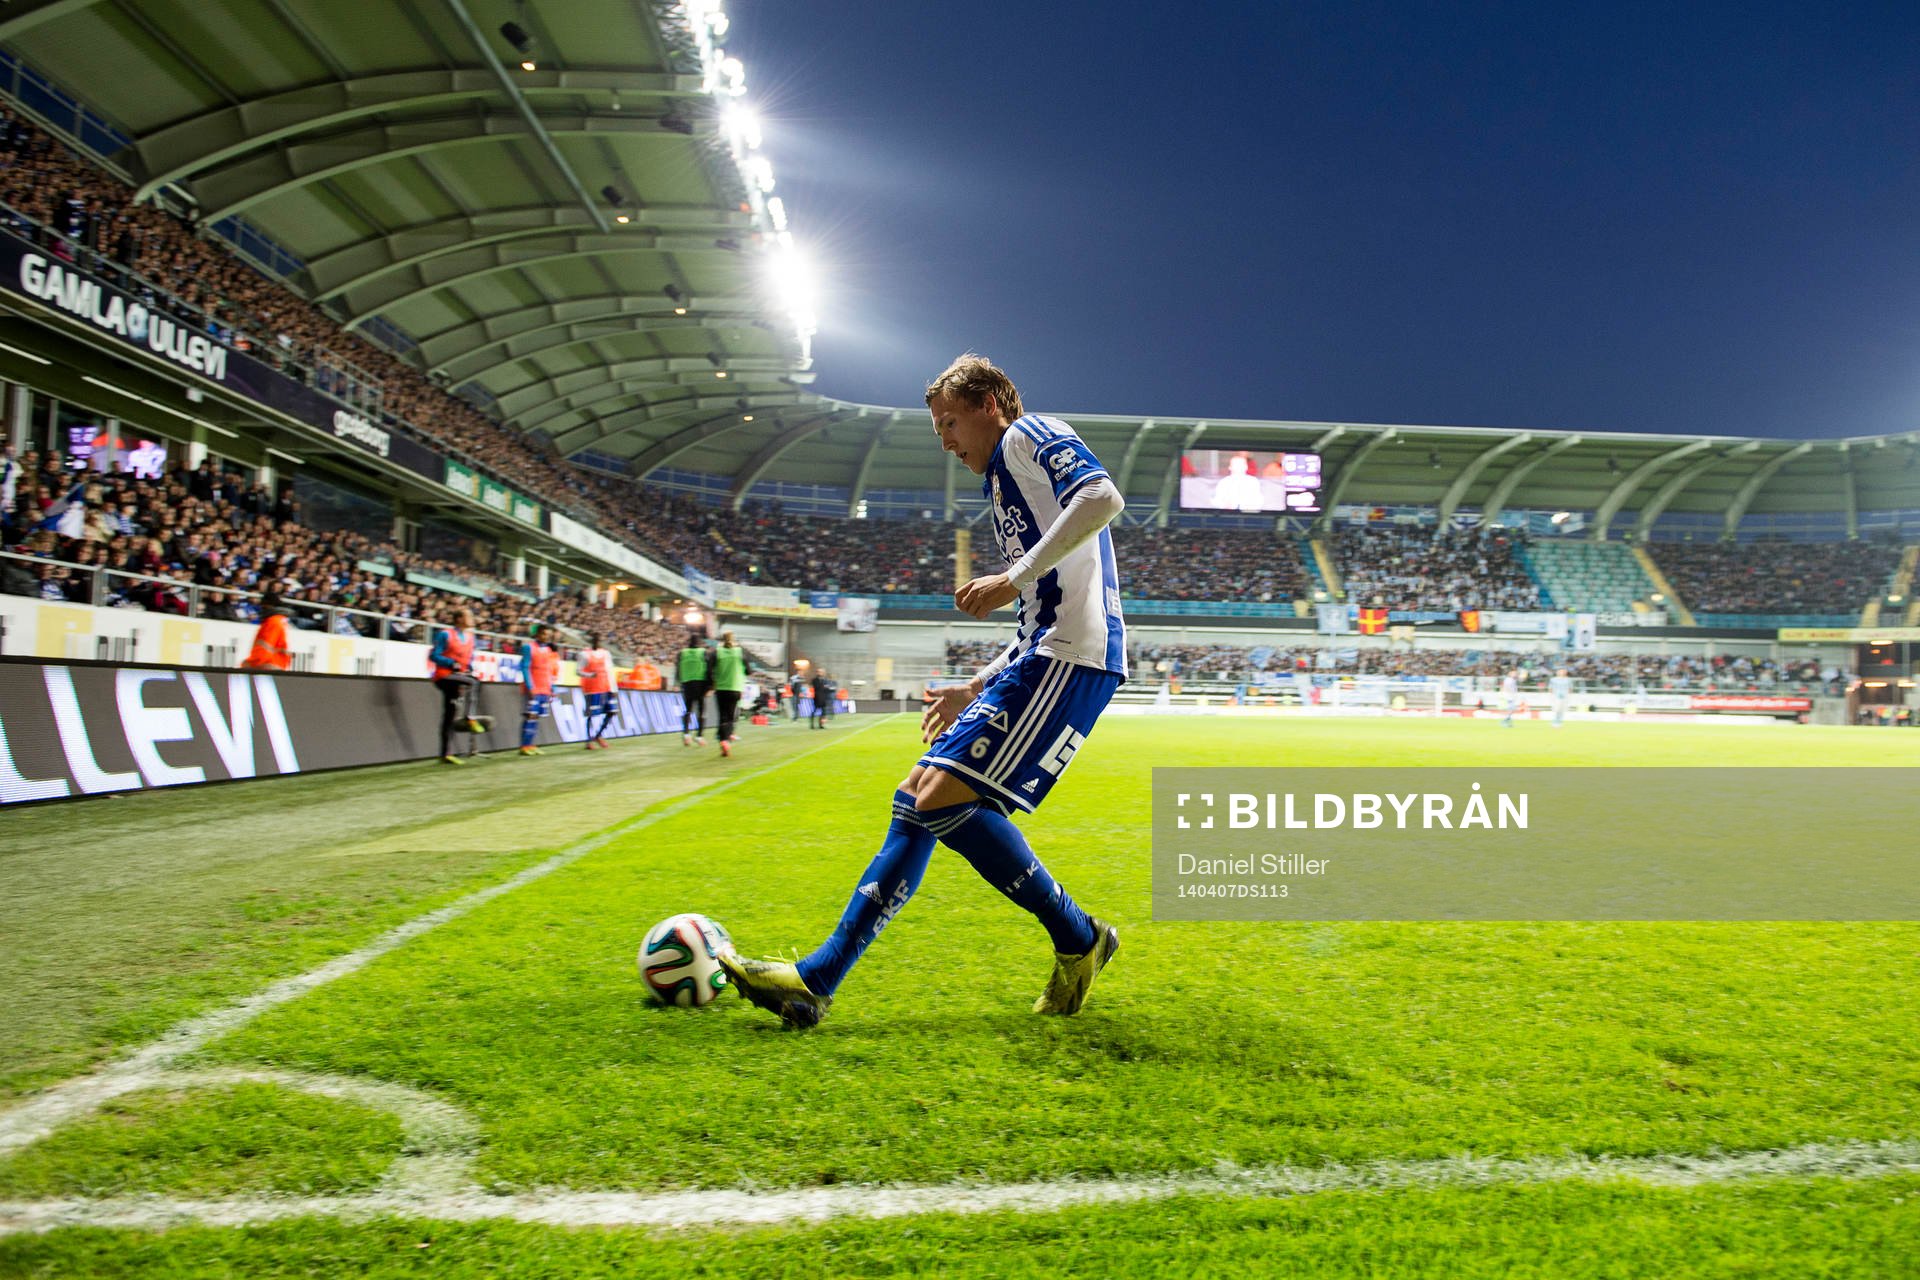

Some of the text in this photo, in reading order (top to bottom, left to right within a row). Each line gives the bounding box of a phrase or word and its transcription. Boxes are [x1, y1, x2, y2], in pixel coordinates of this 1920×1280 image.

[20, 253, 227, 380] GAMLA ULLEVI
[970, 736, 992, 759] 6
[1005, 860, 1039, 893] IFK
